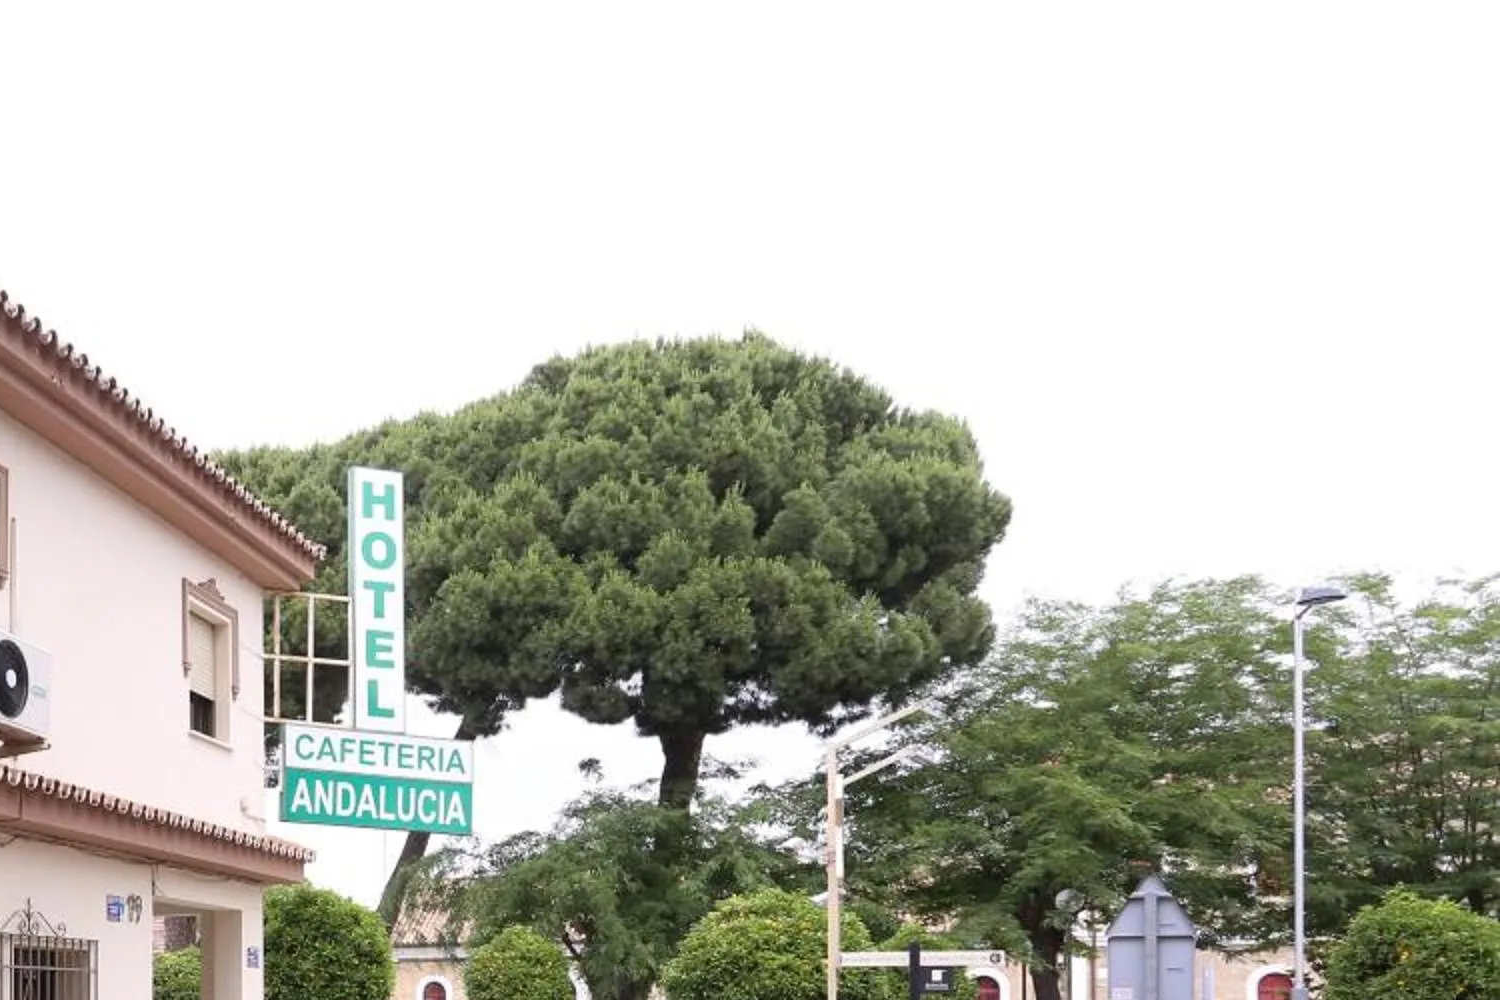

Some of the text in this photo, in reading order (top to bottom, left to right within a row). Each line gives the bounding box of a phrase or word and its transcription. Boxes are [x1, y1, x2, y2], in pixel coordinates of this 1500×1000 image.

[360, 480, 397, 719] HOTEL
[295, 733, 467, 775] CAFETERIA
[291, 777, 467, 827] ANDALUCIA
